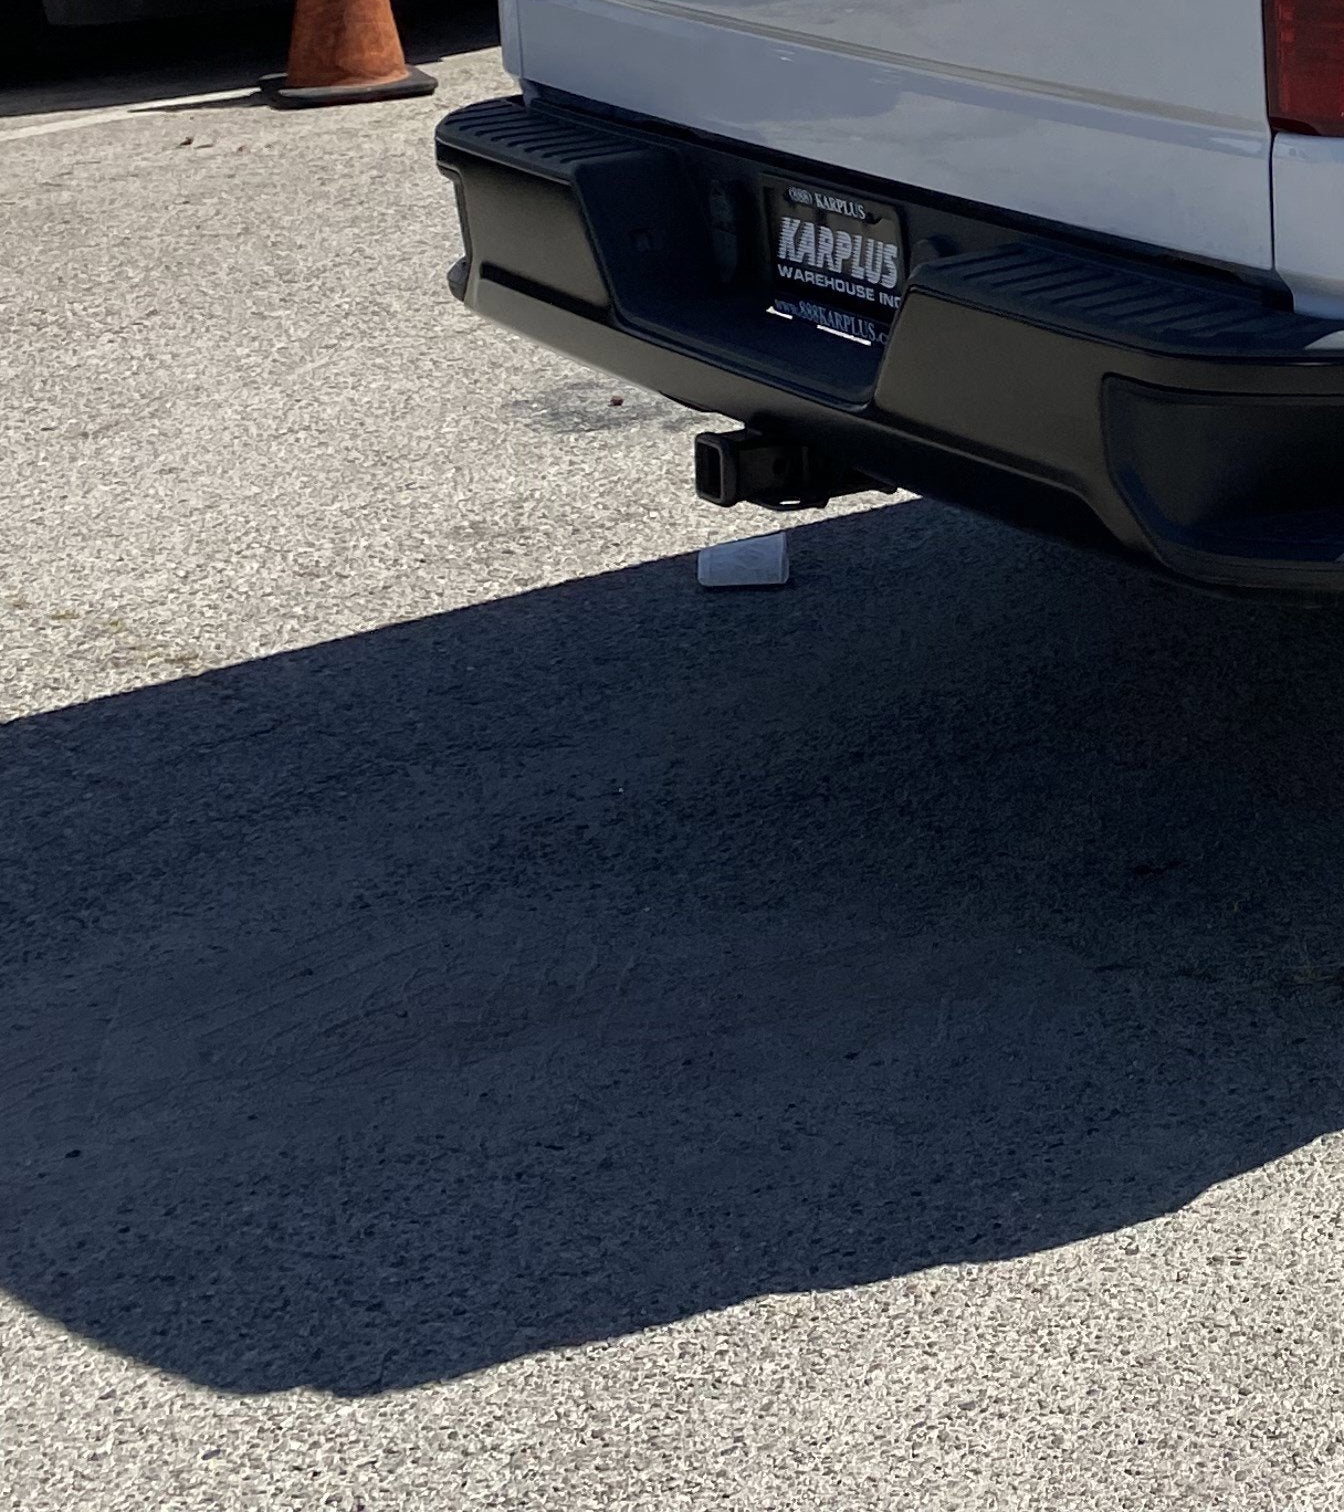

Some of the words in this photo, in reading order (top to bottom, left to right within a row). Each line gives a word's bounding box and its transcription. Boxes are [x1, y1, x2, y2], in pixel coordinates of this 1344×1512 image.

[814, 192, 867, 220] KARPLUS
[777, 216, 898, 289] KARPLUS
[777, 264, 875, 301] WAREHOUSE
